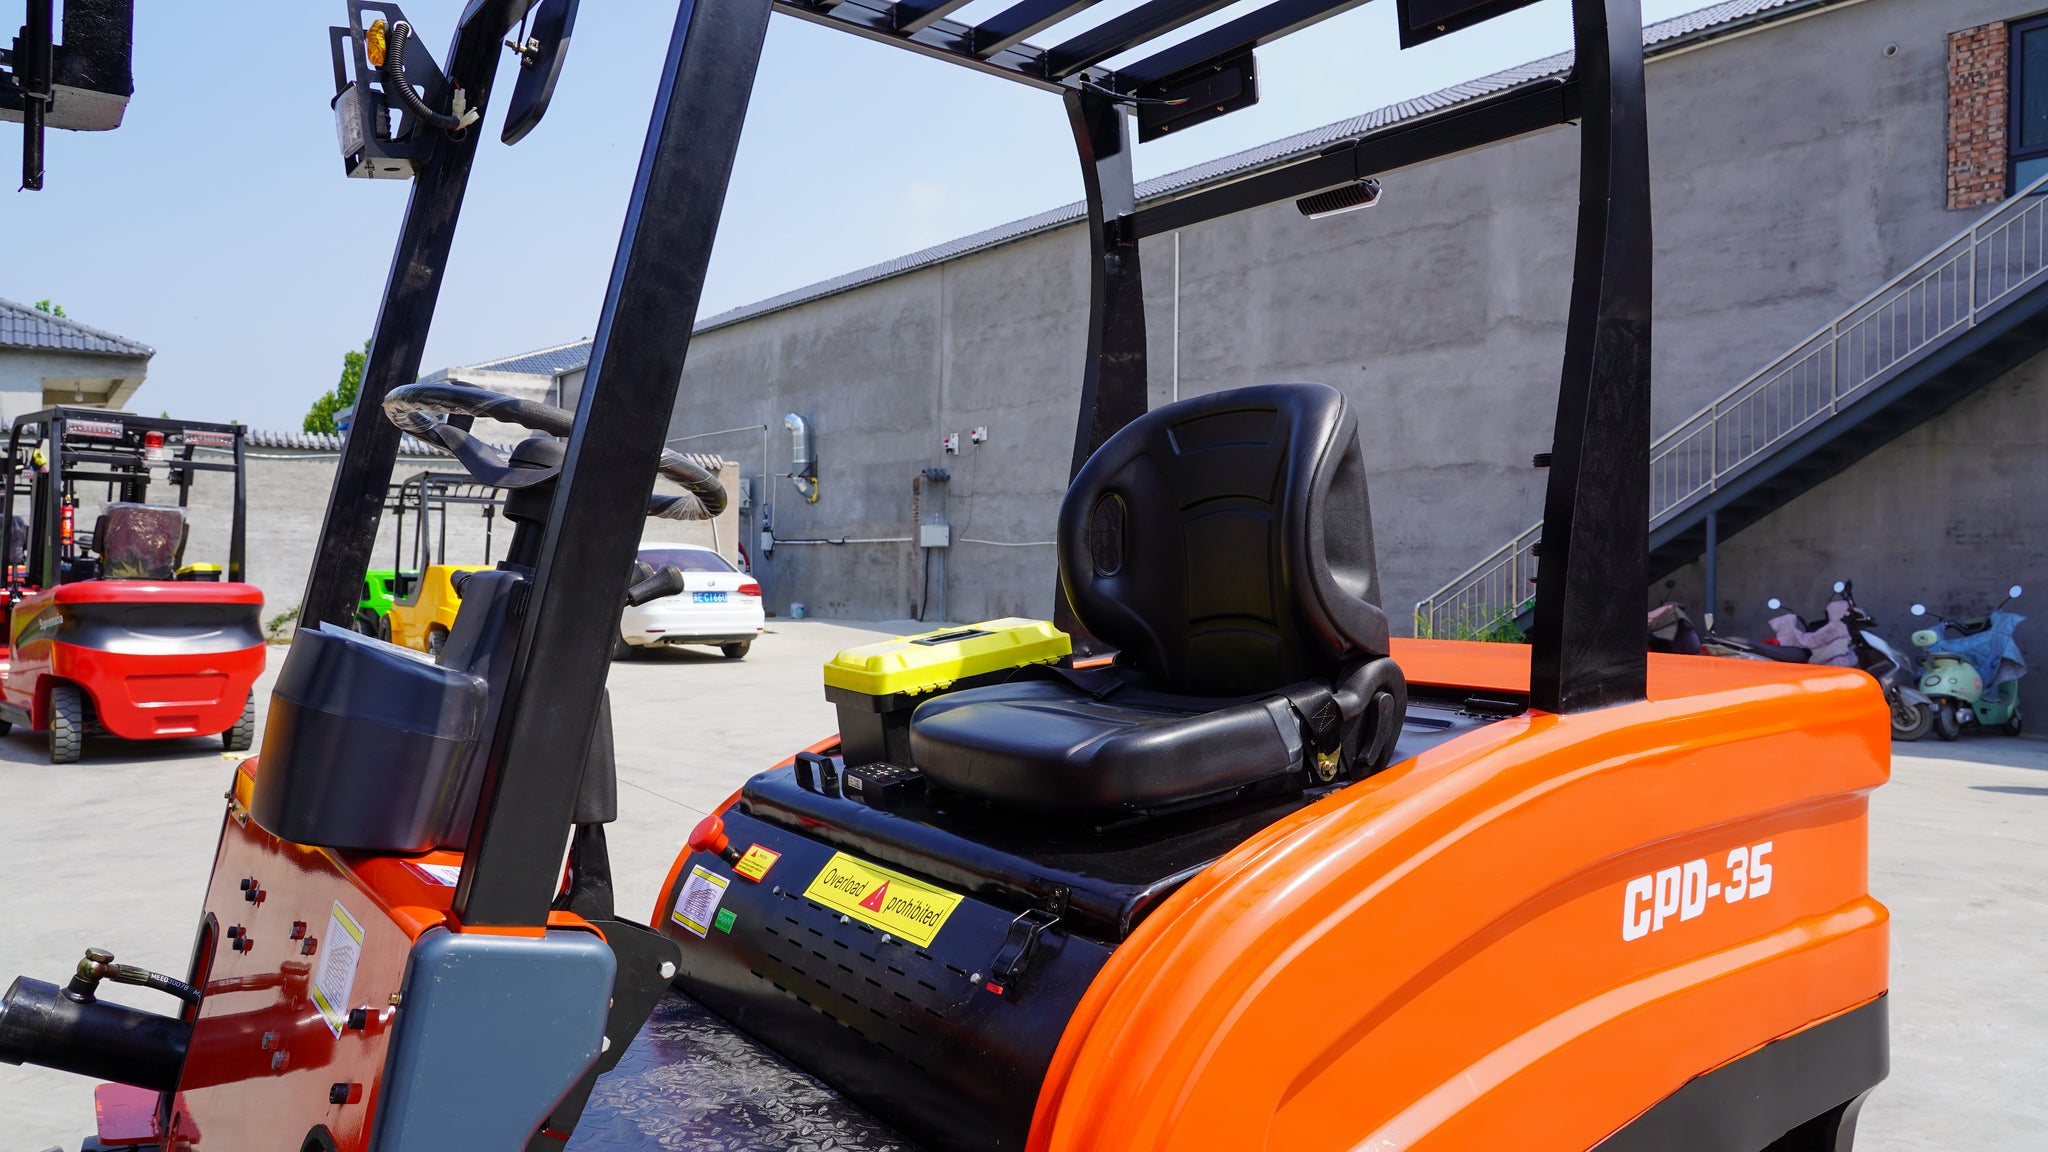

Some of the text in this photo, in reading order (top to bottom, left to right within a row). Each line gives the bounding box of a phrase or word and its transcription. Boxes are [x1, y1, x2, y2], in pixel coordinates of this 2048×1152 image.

[823, 867, 944, 927] Overload prohibited
[1622, 840, 1773, 942] CPD-35
